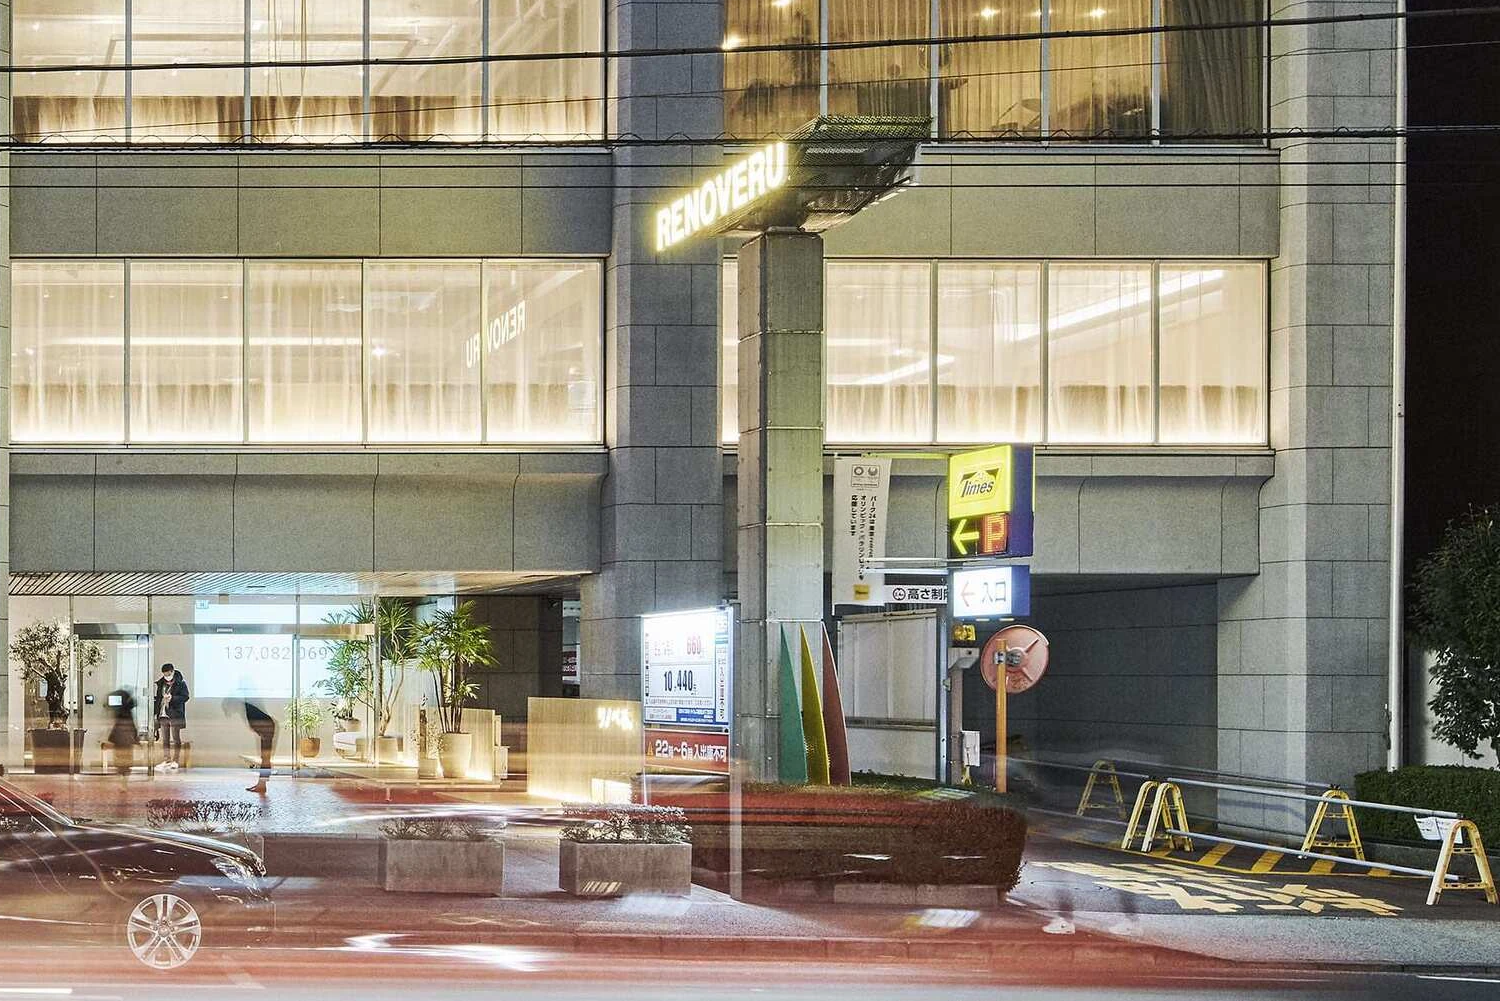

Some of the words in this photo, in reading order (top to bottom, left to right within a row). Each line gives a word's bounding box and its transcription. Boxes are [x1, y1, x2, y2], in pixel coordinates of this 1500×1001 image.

[657, 142, 786, 251] RENOVERU
[961, 479, 995, 498] Times
[986, 515, 1005, 552] P
[982, 581, 1006, 603] 入口
